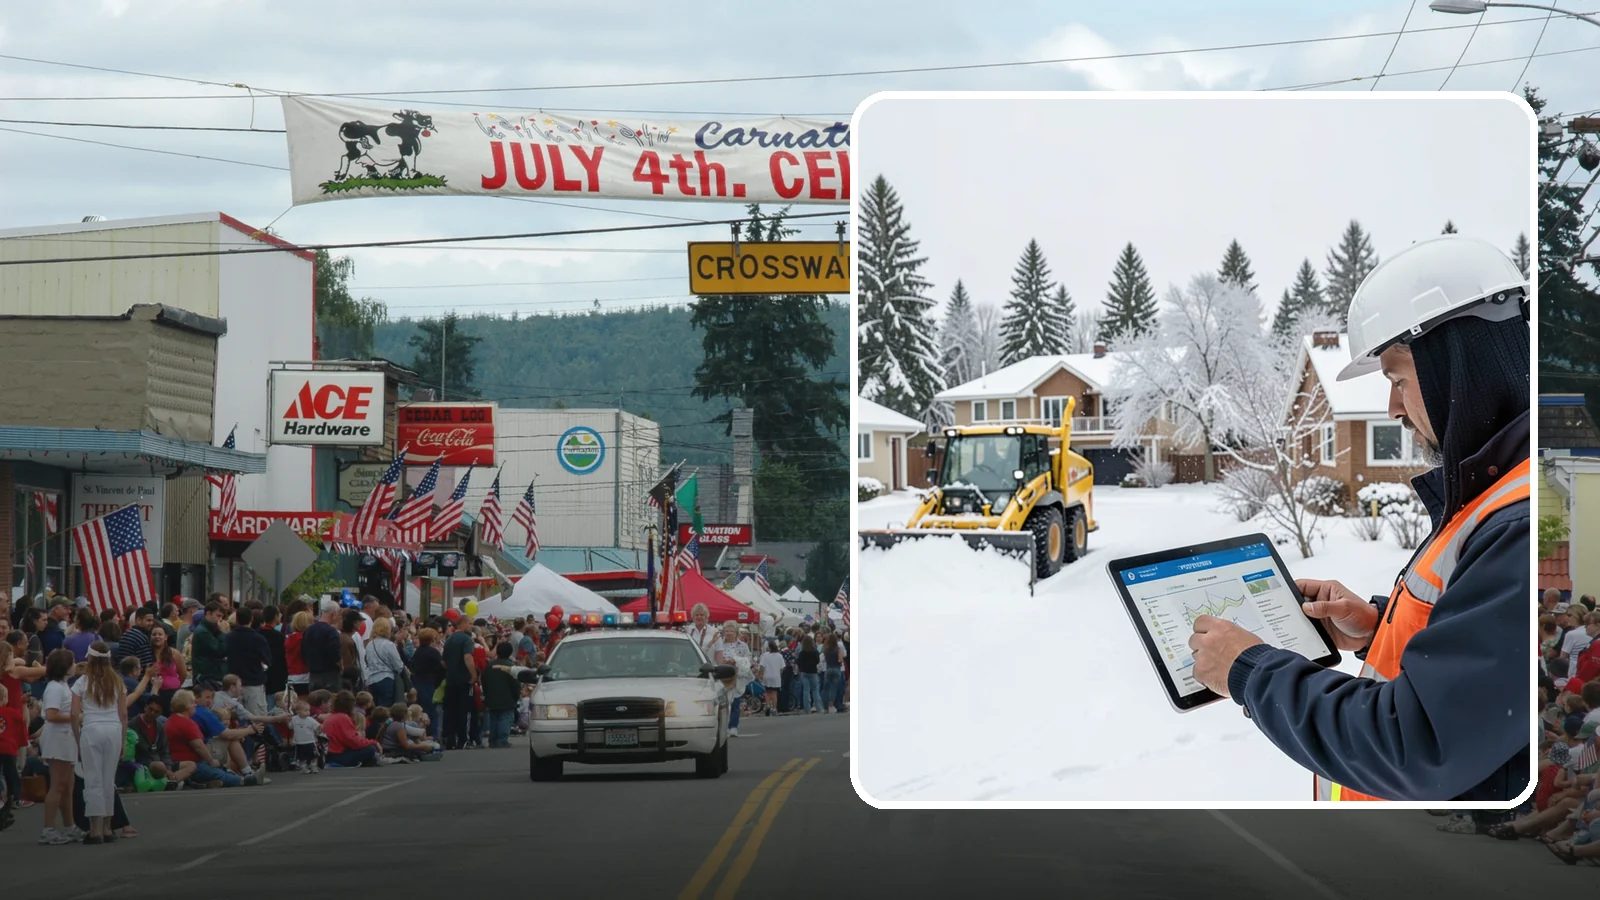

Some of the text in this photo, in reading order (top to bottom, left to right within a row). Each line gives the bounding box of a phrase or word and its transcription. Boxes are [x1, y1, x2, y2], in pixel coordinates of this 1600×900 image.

[481, 141, 604, 192] JULY
[632, 150, 746, 197] 4th.
[697, 254, 850, 280] CROSSWA
[283, 380, 373, 420] ACE
[283, 421, 371, 436] Hardware
[416, 428, 477, 446] Coca-Cola
[96, 485, 124, 494] Vincent
[126, 486, 135, 494] de
[137, 486, 155, 495] Paul
[81, 503, 154, 522] THT
[688, 526, 741, 535] CRNATION
[699, 535, 730, 543] GLASS
